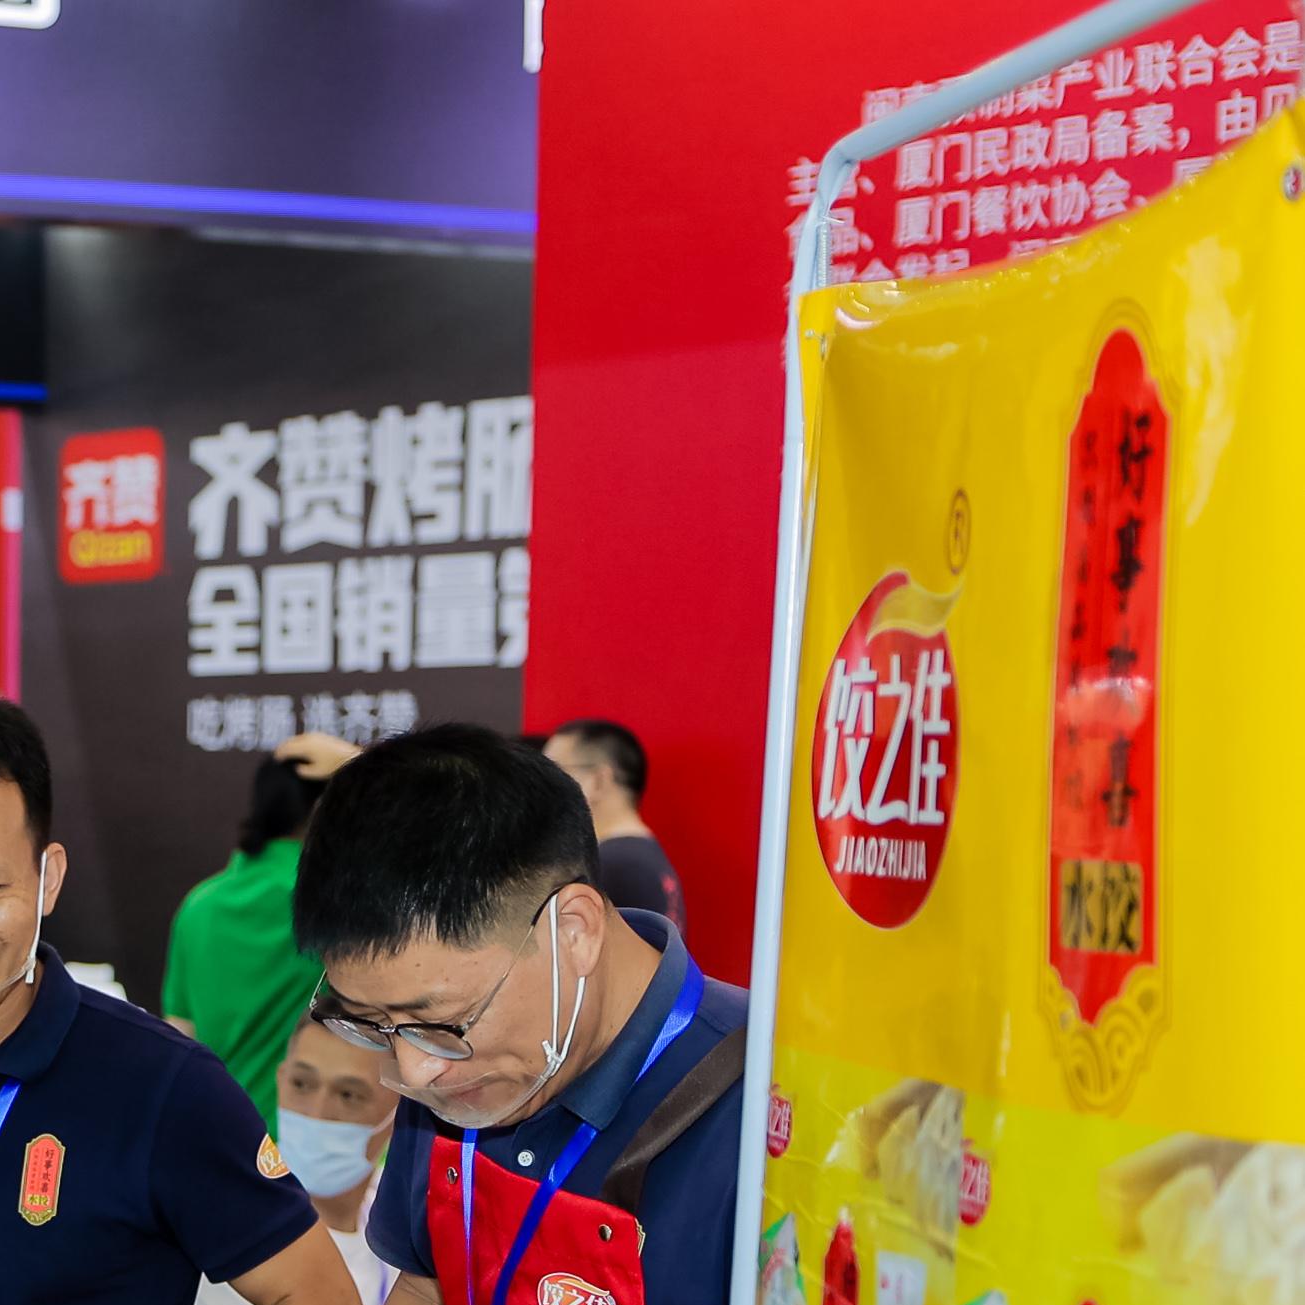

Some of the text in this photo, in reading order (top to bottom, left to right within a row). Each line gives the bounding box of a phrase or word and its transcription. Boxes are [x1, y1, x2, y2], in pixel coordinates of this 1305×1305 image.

[64, 454, 159, 528] 齐赞
[818, 648, 952, 826] 饺之佳
[834, 837, 928, 881] JIAOZHIJIA
[1063, 860, 1141, 952] 水饺
